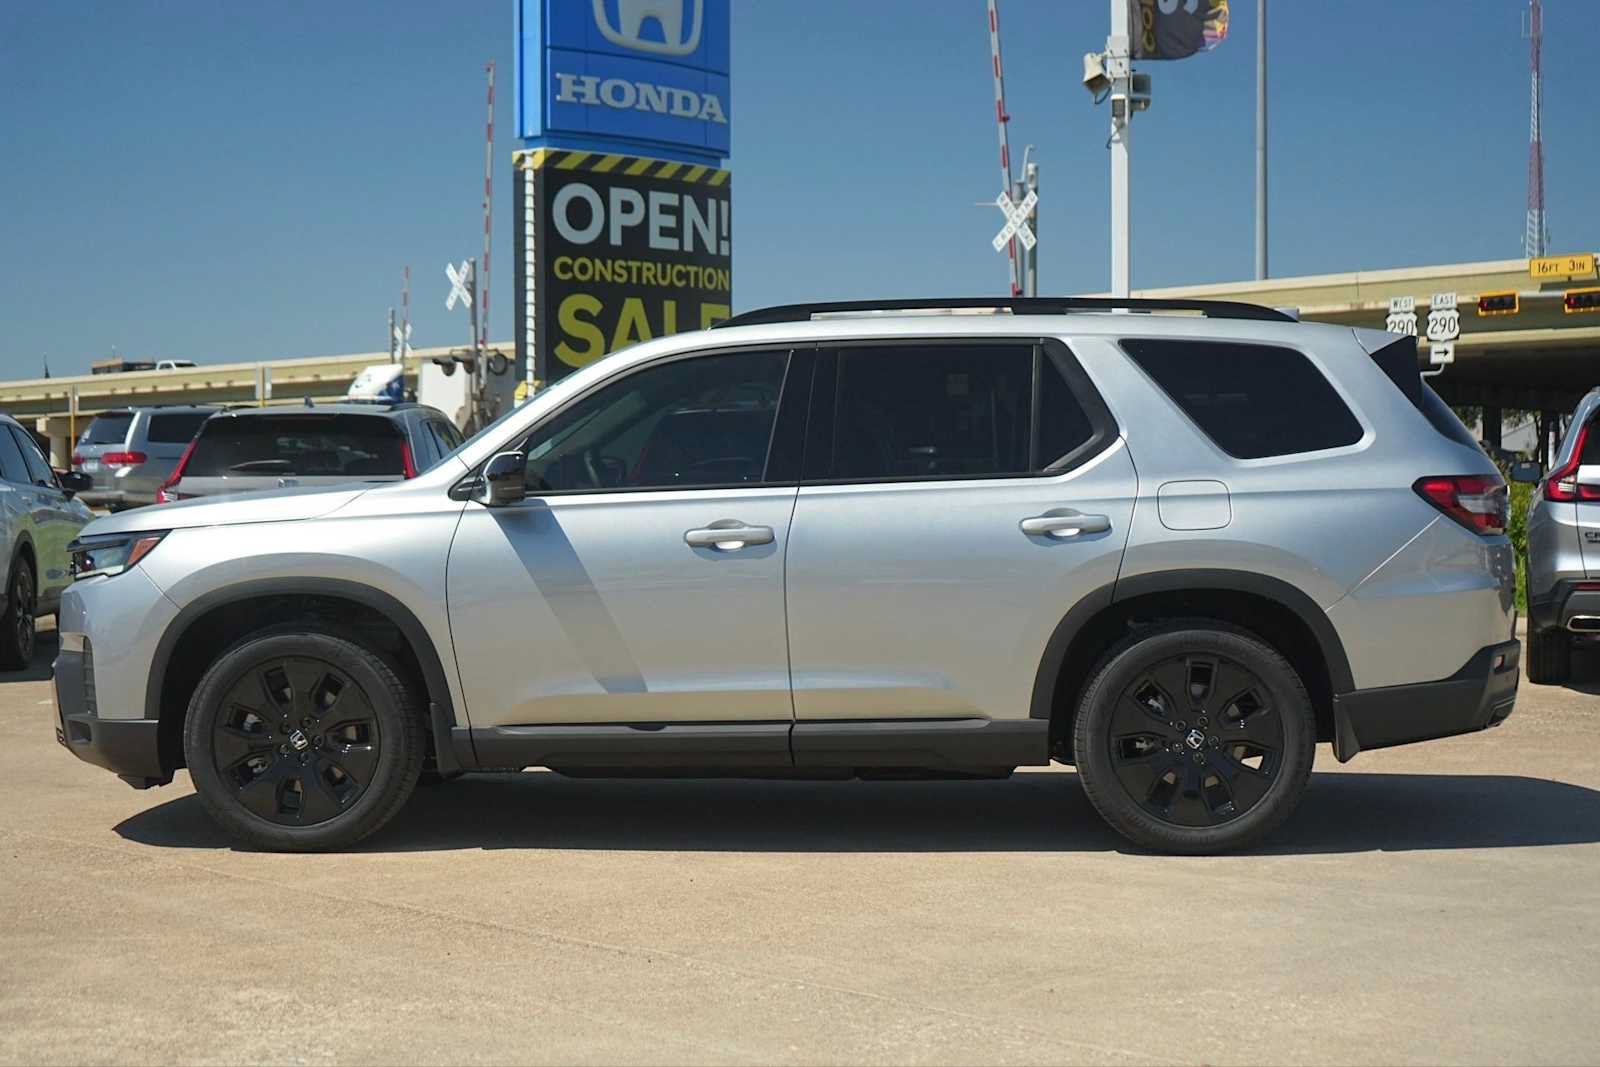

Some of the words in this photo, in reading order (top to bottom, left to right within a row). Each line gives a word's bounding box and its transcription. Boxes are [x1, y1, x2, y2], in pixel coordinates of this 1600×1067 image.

[555, 72, 728, 124] HONDA
[552, 183, 730, 256] OPEN!
[553, 255, 730, 290] CONSTRUCTION
[554, 293, 731, 368] SA
[1390, 319, 1414, 335] 290
[1431, 316, 1456, 335] 290
